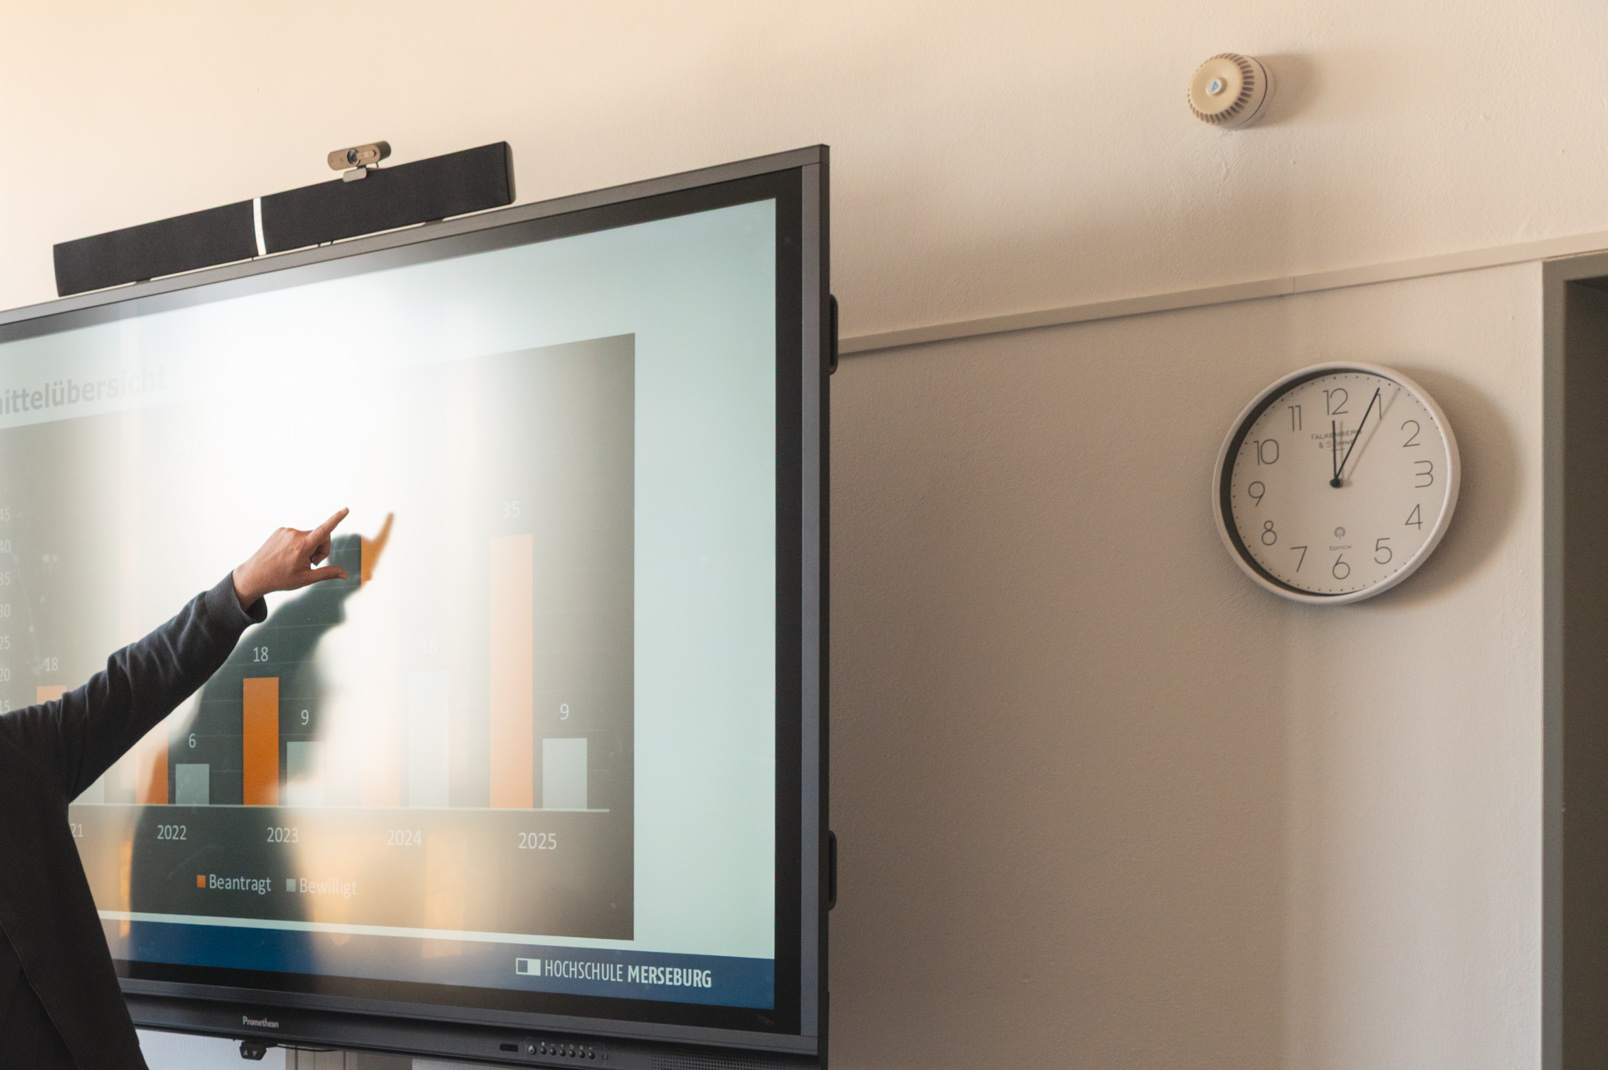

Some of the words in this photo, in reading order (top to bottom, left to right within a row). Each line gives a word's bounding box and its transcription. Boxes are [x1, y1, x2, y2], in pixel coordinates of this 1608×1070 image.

[1322, 387, 1349, 416] 12
[1288, 404, 1302, 432] 11
[1401, 419, 1421, 448] 2
[1253, 438, 1280, 466] 10
[1413, 460, 1434, 489] 3
[1247, 480, 1266, 507] 9
[501, 501, 521, 519] 35
[1404, 503, 1424, 530] 4
[1261, 519, 1277, 546] 8
[1290, 545, 1308, 573] 7
[1373, 537, 1393, 565] 5
[1331, 553, 1351, 580] 6
[44, 657, 59, 672] 18
[252, 646, 269, 663] 18
[300, 709, 310, 726] 9
[559, 703, 570, 720] 9
[188, 733, 197, 749] 6
[70, 822, 84, 838] 21
[157, 824, 187, 840] 2022
[266, 826, 299, 844] 2023
[386, 829, 423, 846] 2024
[518, 831, 557, 850] 2025
[209, 873, 272, 894] Beantragt
[299, 876, 358, 898] Bewilligt
[544, 959, 624, 983] HOCHSCHULE
[627, 965, 713, 988] MERSEBURG
[242, 1015, 280, 1029] Promethean
